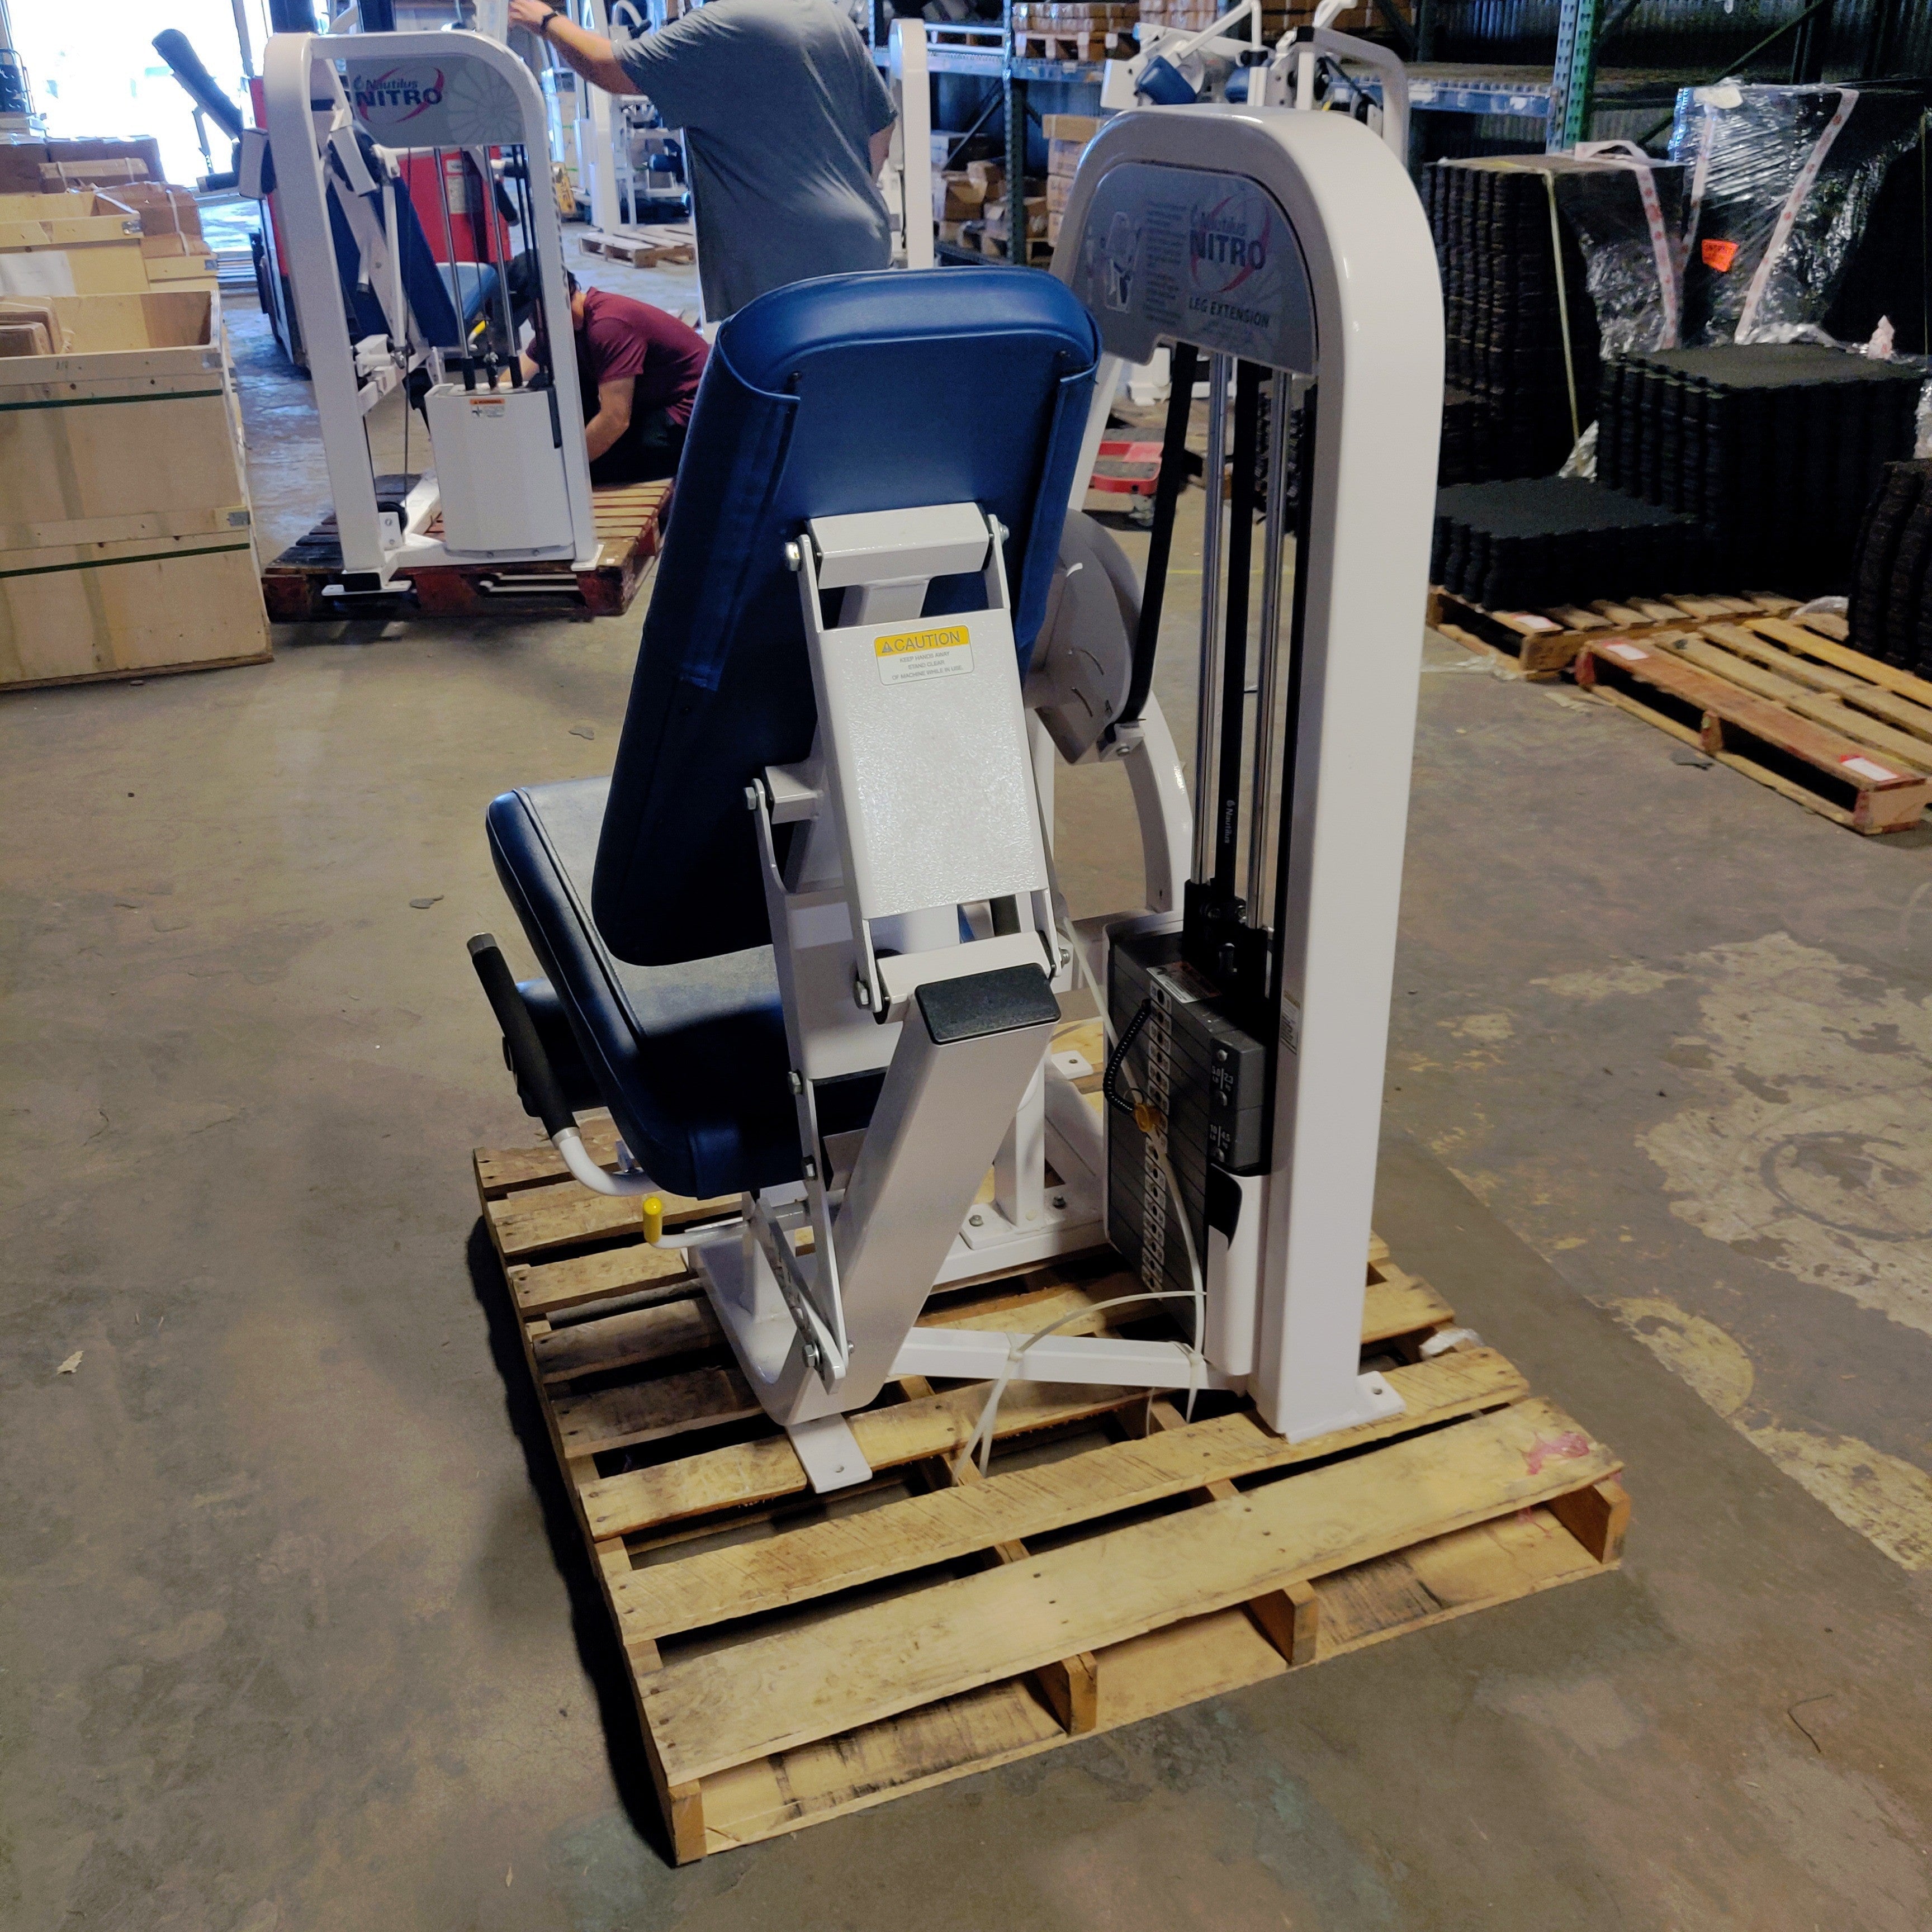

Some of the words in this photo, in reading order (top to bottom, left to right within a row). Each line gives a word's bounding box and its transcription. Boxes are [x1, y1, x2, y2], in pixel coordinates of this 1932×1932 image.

[355, 88, 443, 107] NITRO
[1190, 229, 1266, 270] NITRO
[1189, 297, 1208, 312] LEG
[1210, 301, 1270, 328] EXTENSION
[894, 631, 960, 652] CAUTION
[901, 670, 926, 679] MACHINE
